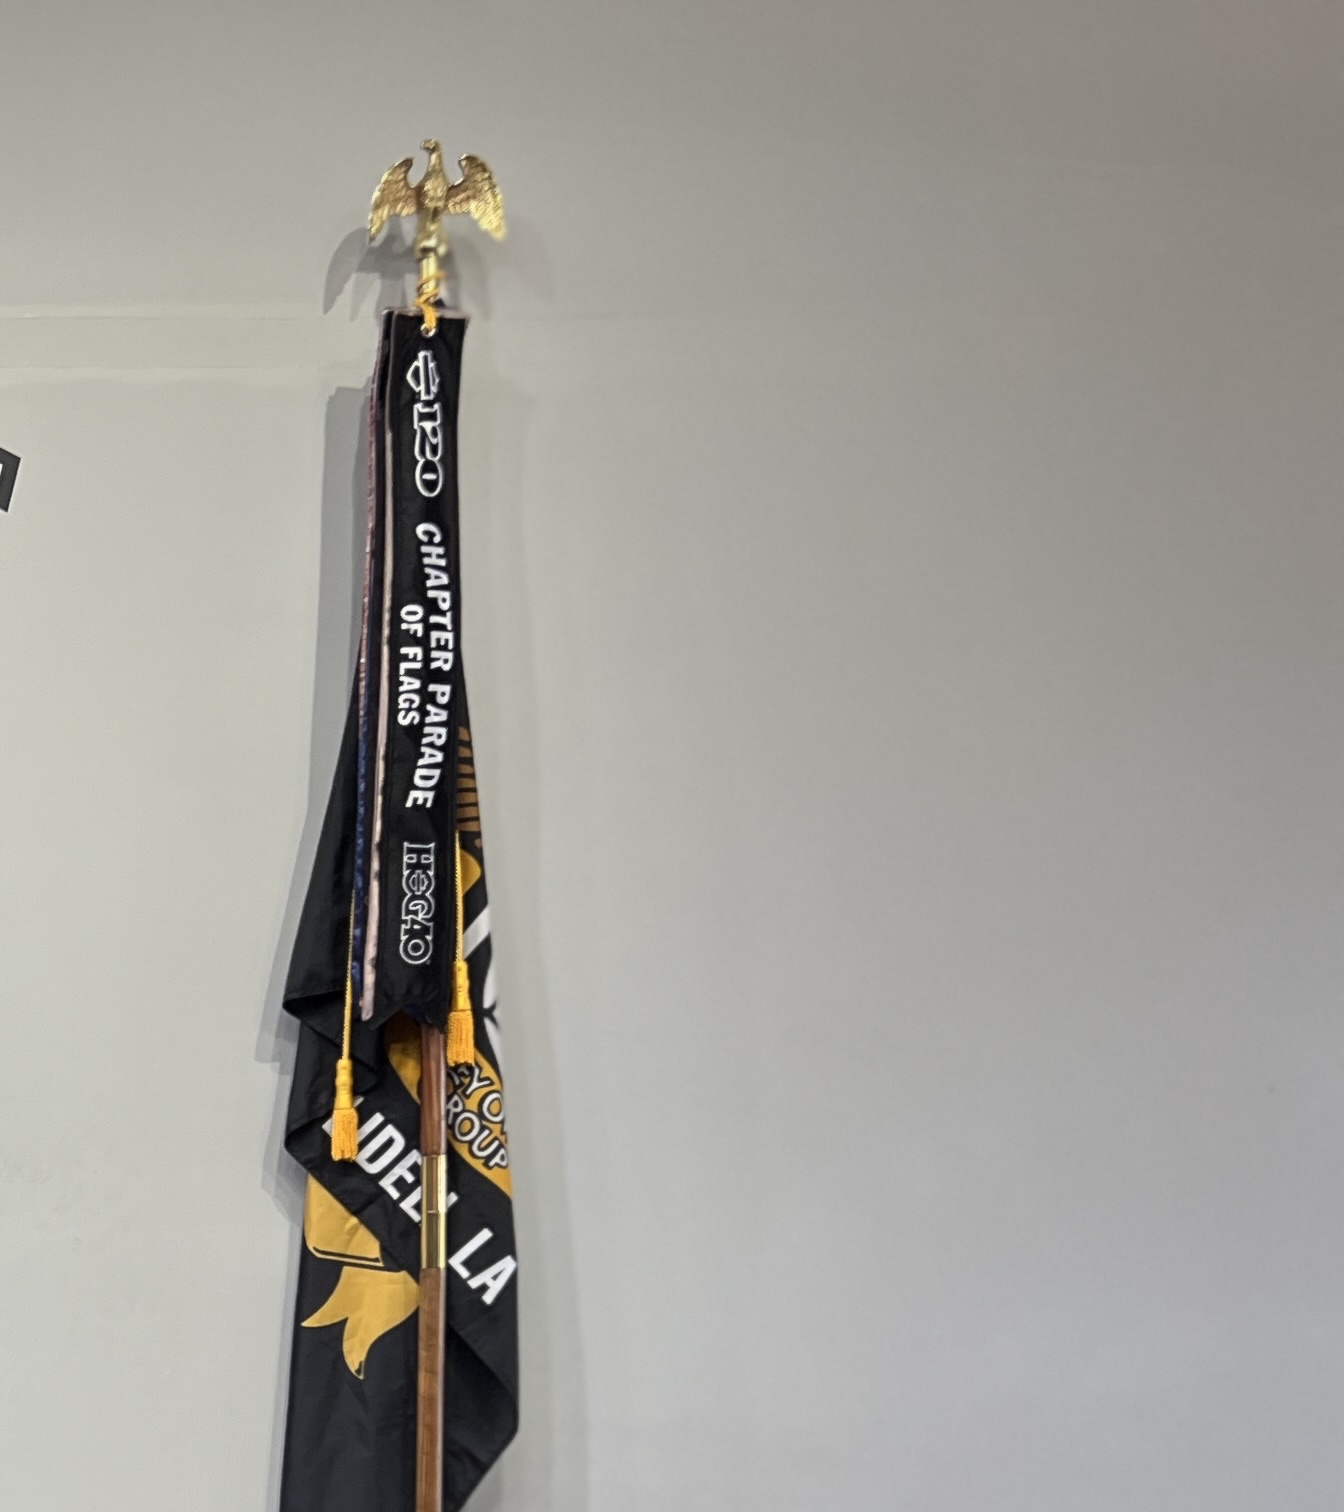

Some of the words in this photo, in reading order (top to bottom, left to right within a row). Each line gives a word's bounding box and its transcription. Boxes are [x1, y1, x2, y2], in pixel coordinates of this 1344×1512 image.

[400, 604, 424, 638] OF
[415, 522, 454, 672] CHAPTER
[398, 646, 423, 727] FLAGS
[405, 683, 452, 810] PARADE
[448, 1228, 517, 1305] LA
